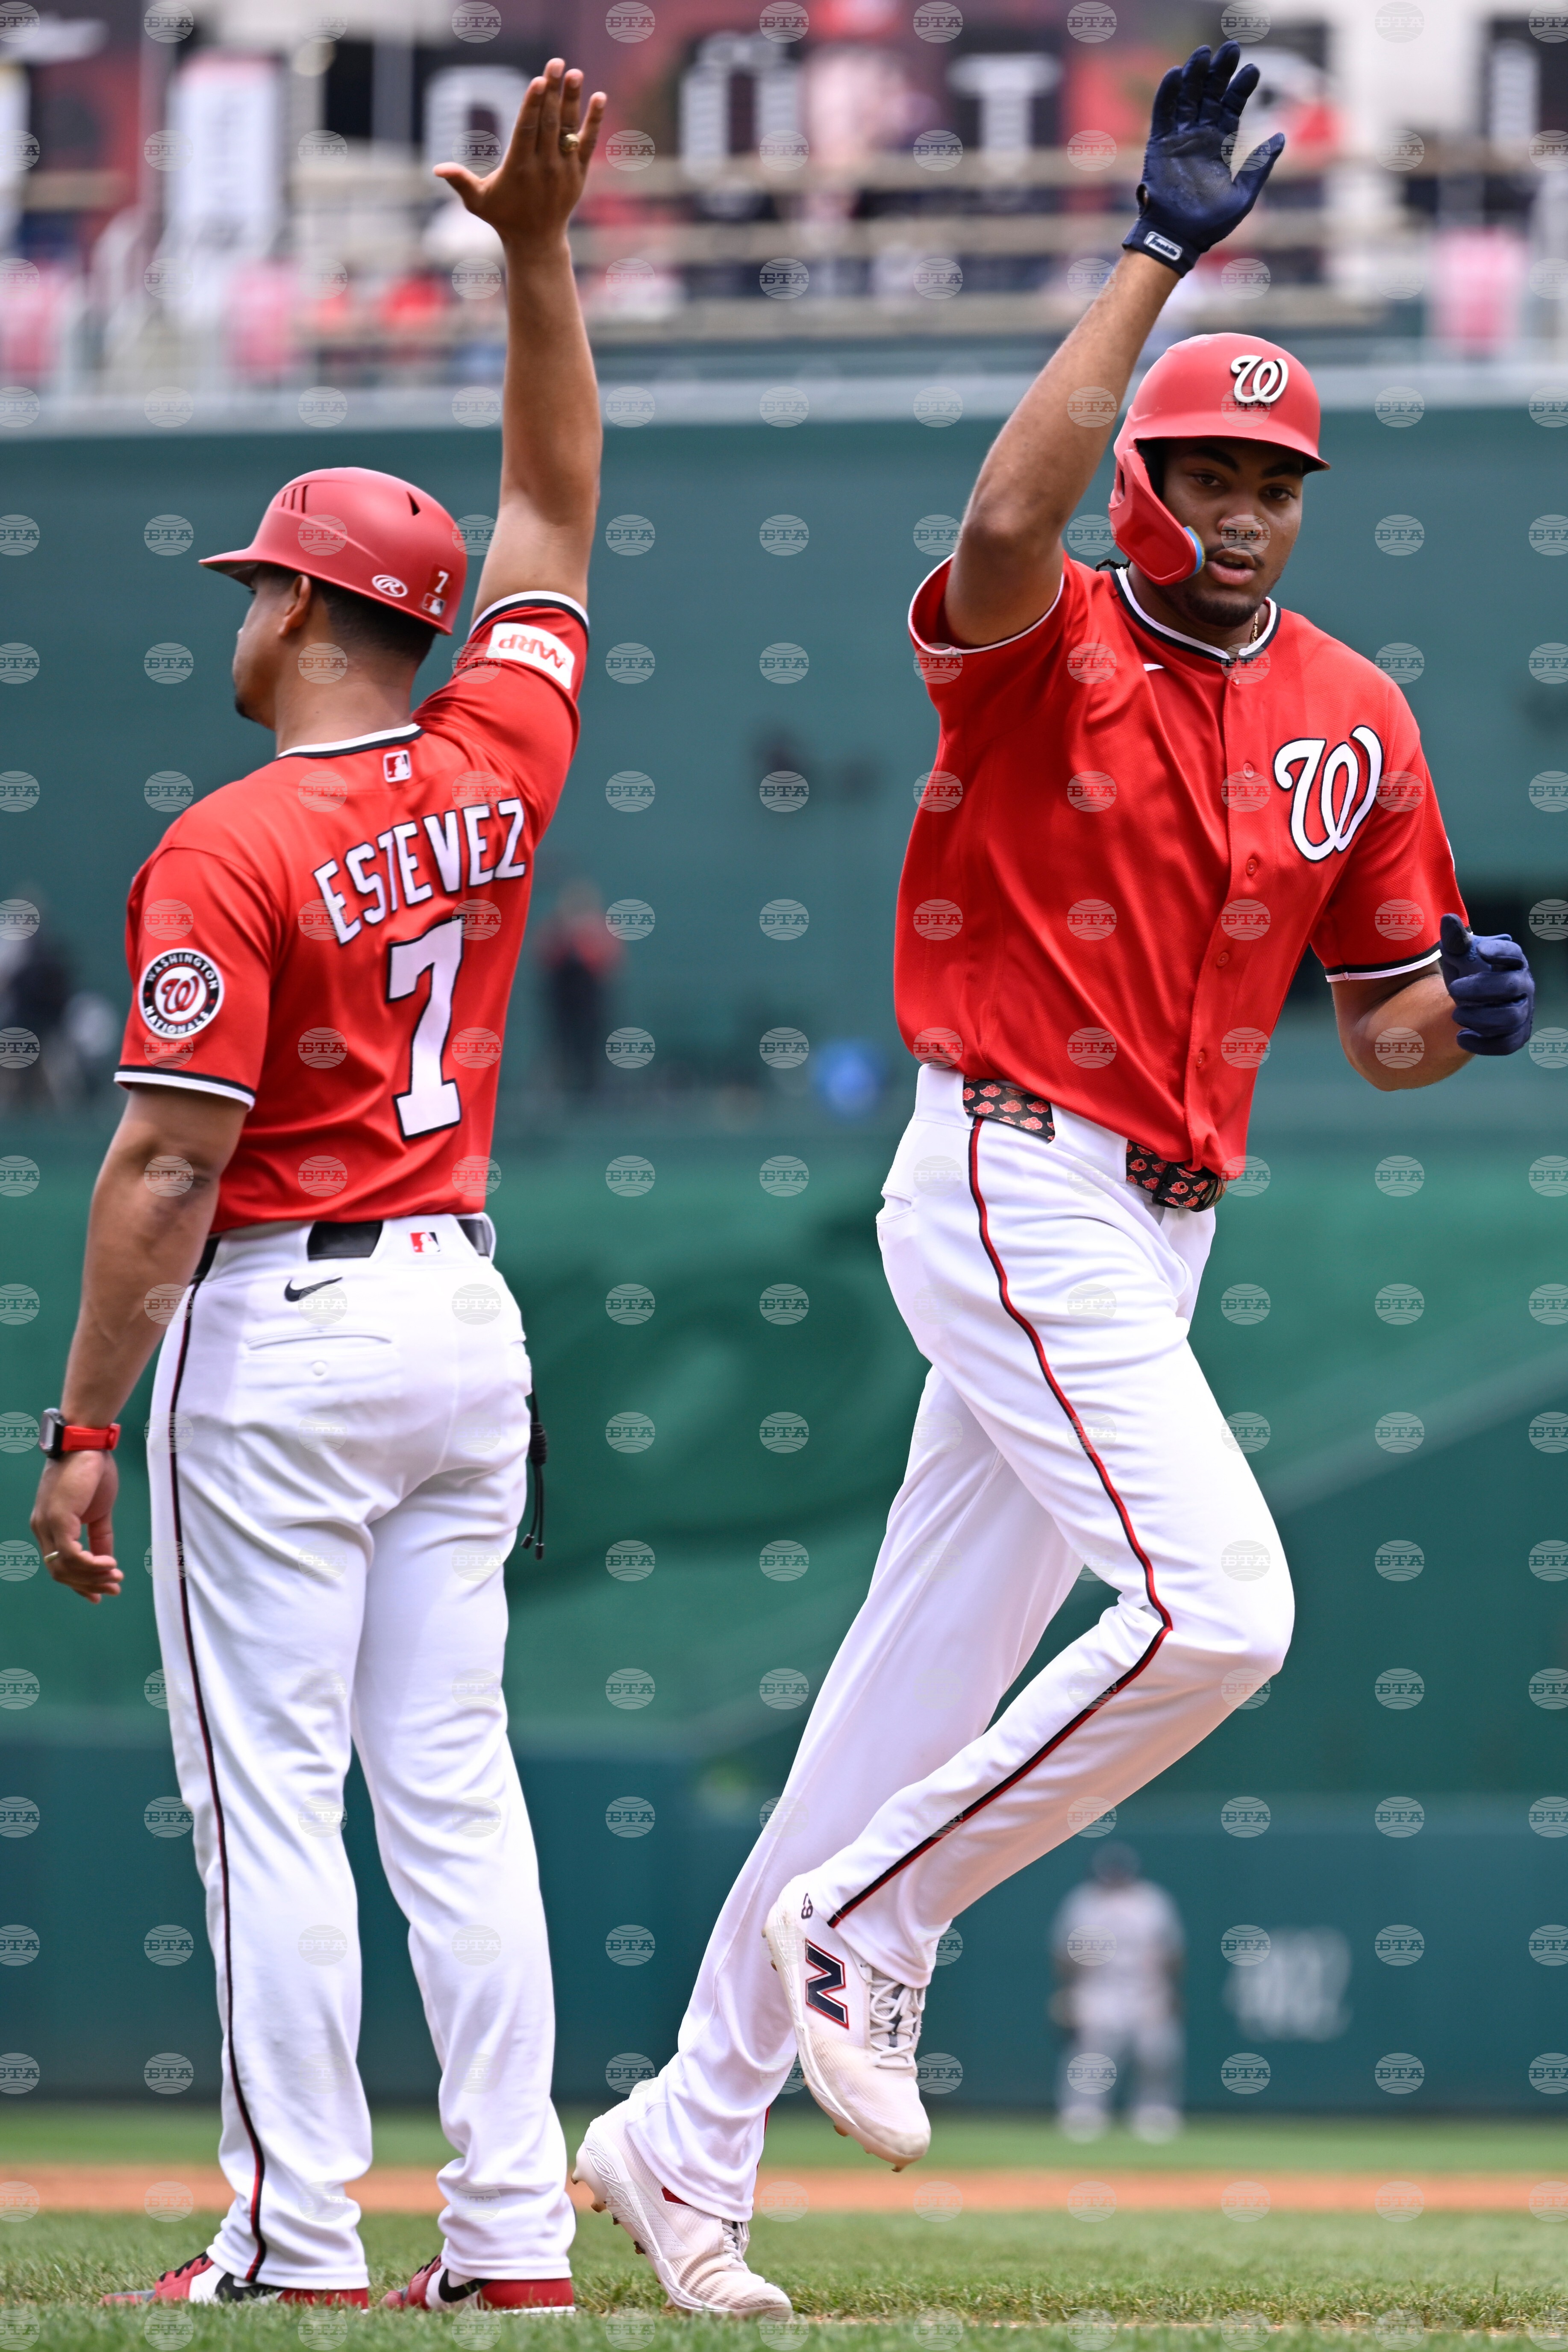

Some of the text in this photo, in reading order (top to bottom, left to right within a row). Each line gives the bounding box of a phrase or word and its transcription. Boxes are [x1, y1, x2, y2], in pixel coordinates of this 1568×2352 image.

[1230, 355, 1289, 403] W
[435, 570, 449, 594] 7
[499, 634, 566, 669] AARP
[1272, 724, 1384, 863] W
[313, 798, 526, 946] ESTEVEZ
[147, 954, 218, 990] WASHINGTON
[161, 975, 200, 1014] W
[144, 1005, 209, 1034] NATIONALS
[386, 914, 466, 1141] 7
[805, 1938, 849, 2030] N
